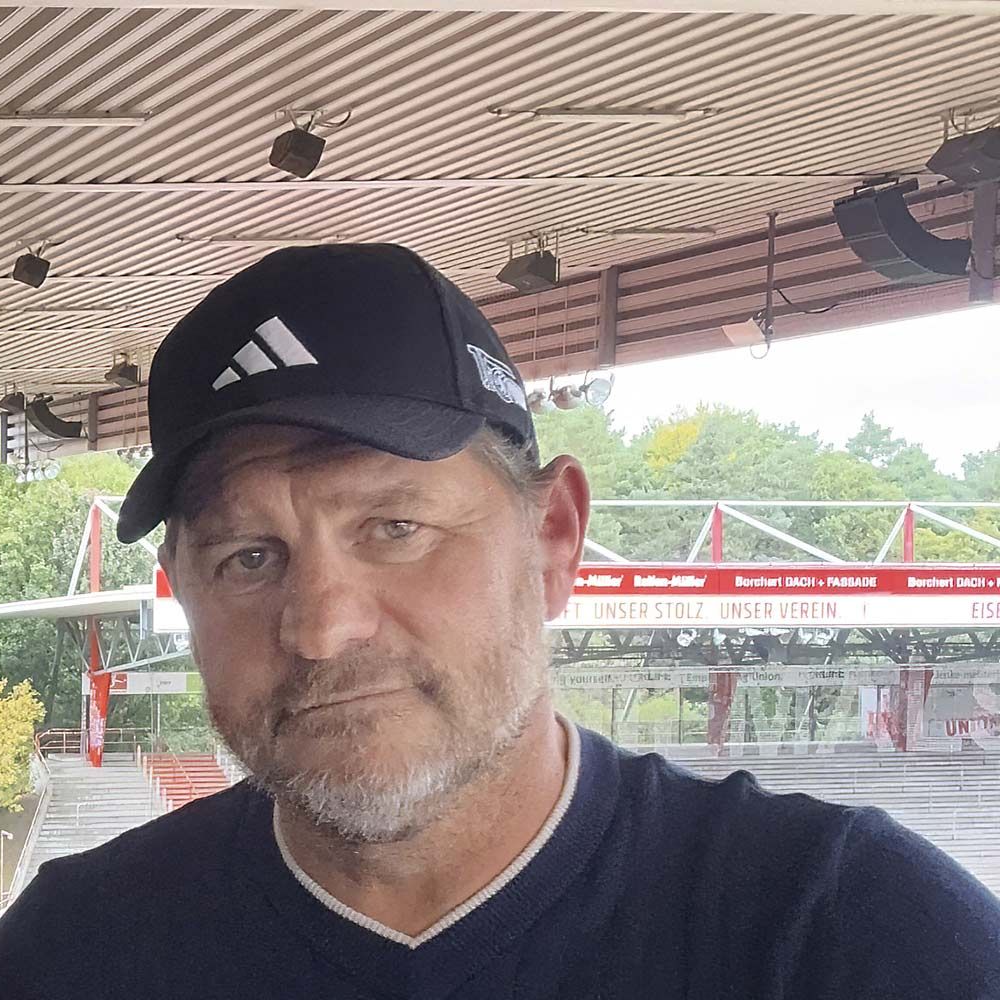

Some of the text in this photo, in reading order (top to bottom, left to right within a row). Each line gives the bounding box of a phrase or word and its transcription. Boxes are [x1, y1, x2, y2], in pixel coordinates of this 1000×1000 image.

[735, 575, 782, 587] Borchert
[785, 576, 815, 587] DACH
[827, 577, 877, 587] FASSADE
[907, 576, 953, 588] Borchert
[956, 577, 985, 588] DACH
[594, 602, 648, 619] UNSER
[720, 602, 773, 619] UNSER
